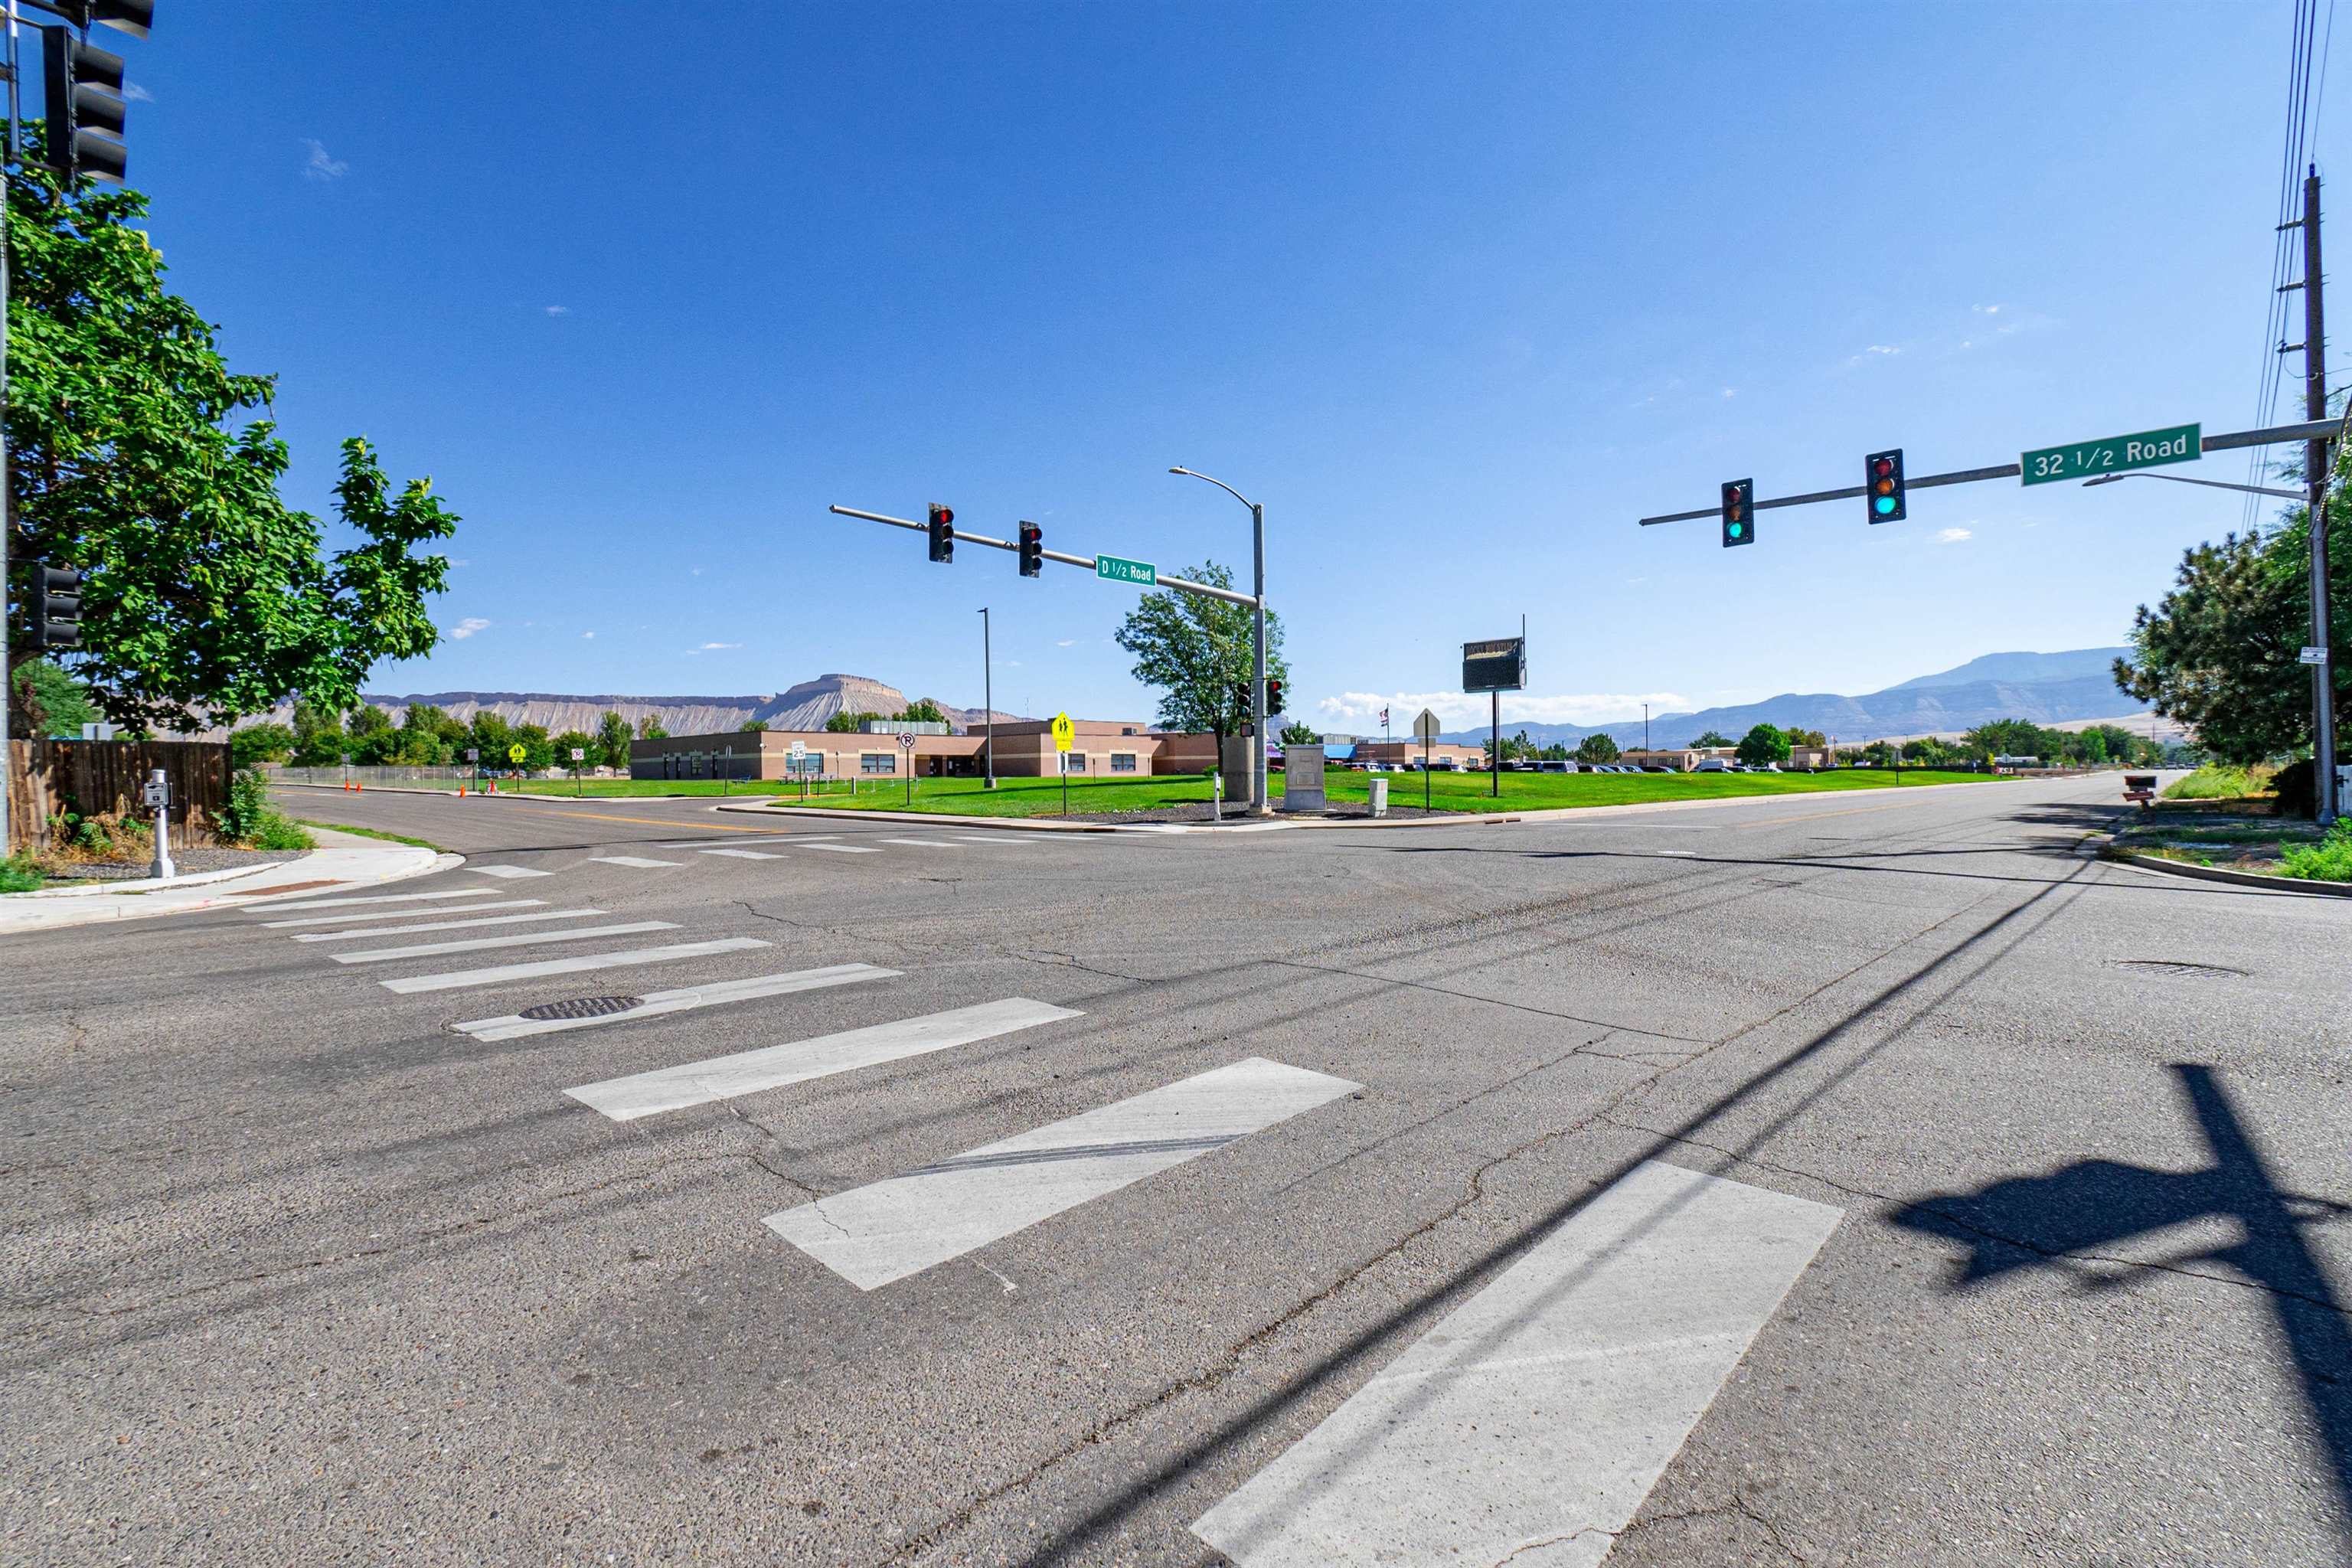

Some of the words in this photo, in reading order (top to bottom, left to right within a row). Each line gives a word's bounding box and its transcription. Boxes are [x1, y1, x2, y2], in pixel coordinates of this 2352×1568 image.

[2034, 454, 2064, 477] 32
[2076, 447, 2114, 469] 1/2
[2126, 434, 2187, 462] Road
[1102, 560, 1109, 573] D
[1112, 562, 1127, 577] 1/2
[1130, 565, 1152, 581] Road
